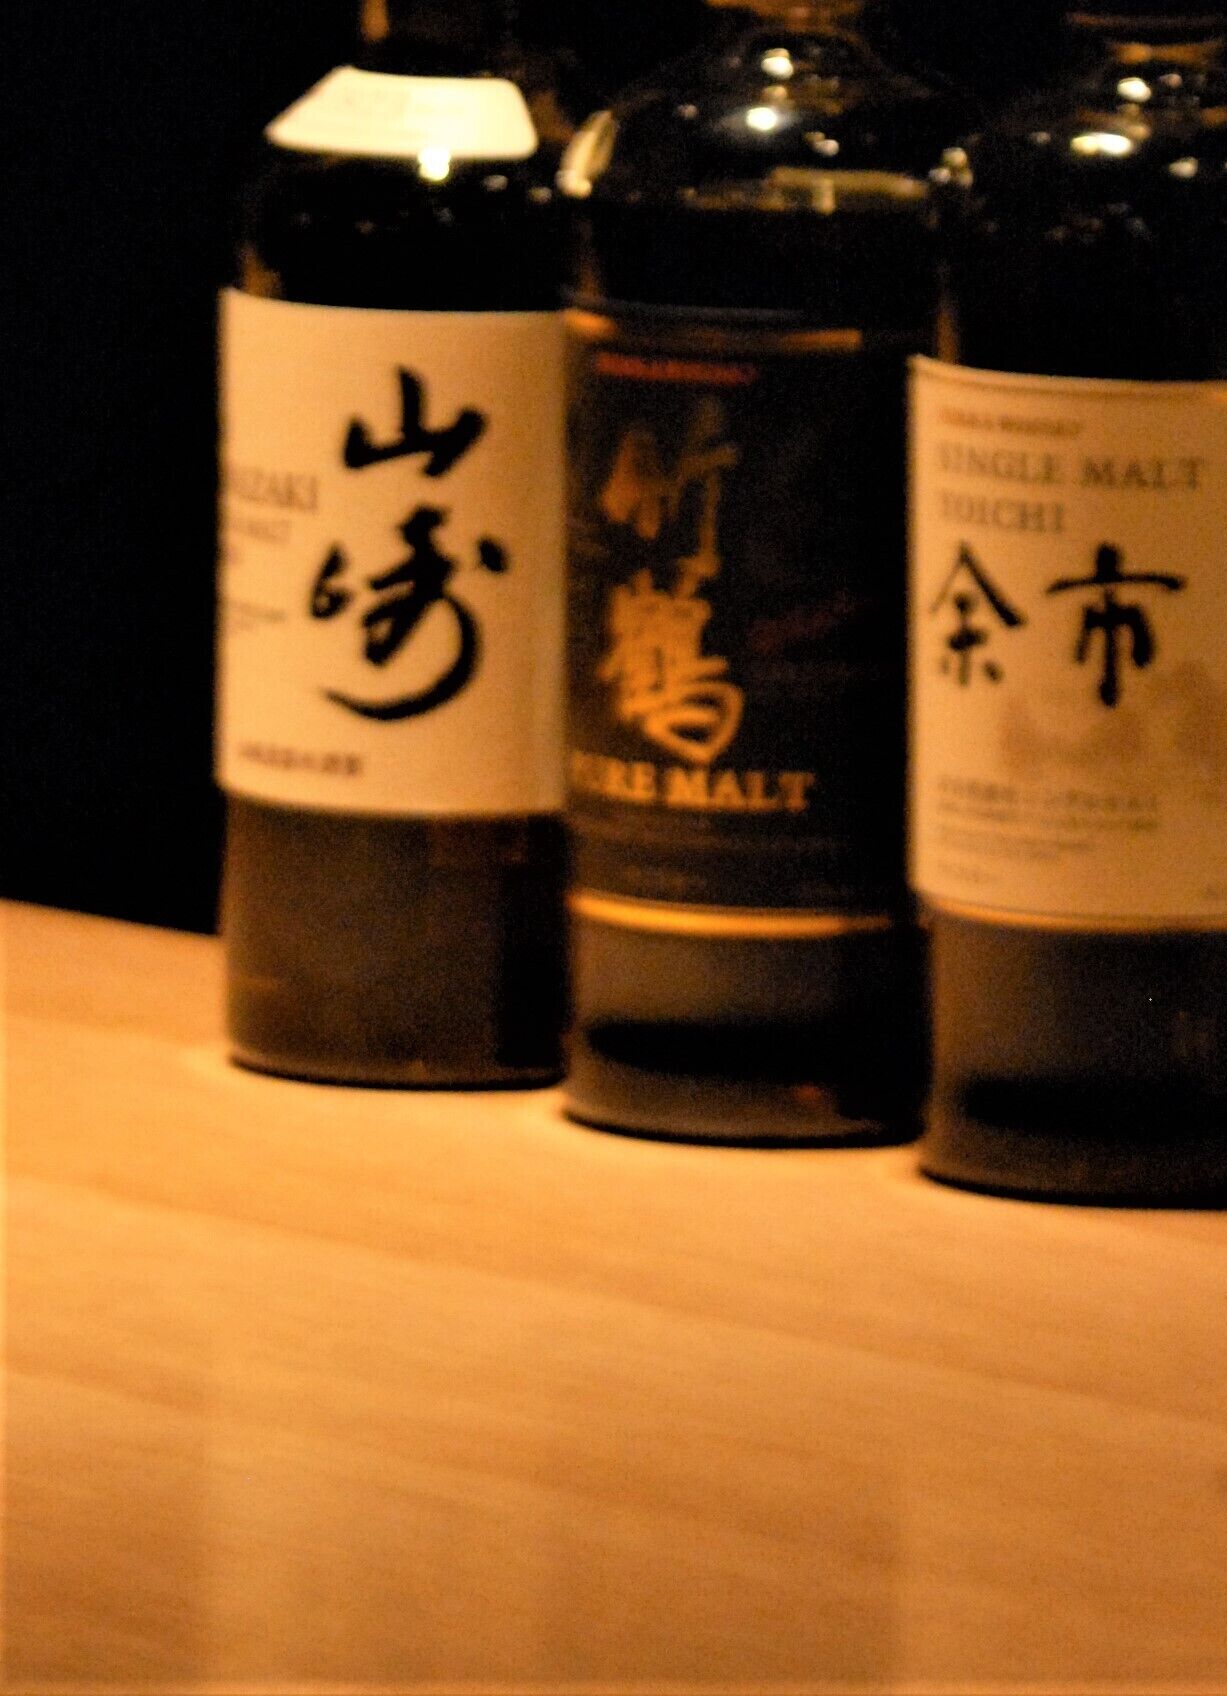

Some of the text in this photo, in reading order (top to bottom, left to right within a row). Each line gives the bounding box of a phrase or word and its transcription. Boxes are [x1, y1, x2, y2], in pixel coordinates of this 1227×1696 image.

[1080, 455, 1206, 491] MALT
[931, 540, 1187, 707] 余市
[666, 767, 816, 813] MALT
